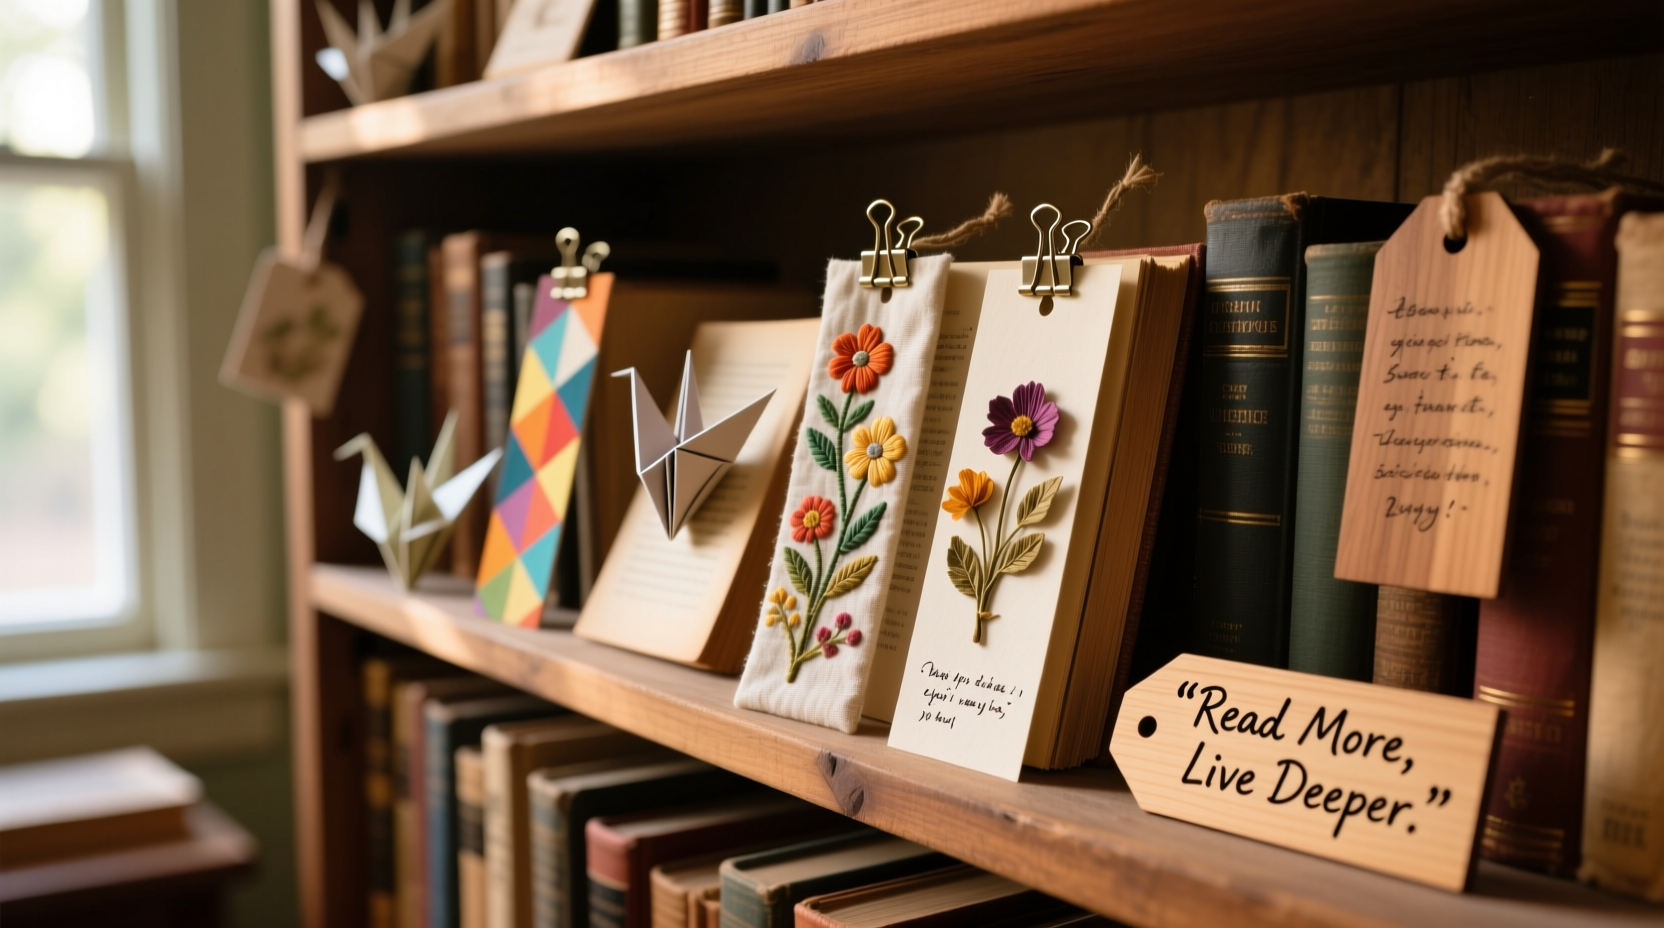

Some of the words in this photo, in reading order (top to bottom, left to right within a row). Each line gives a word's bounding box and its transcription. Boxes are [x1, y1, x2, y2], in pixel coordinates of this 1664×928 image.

[1177, 680, 1292, 741] “Read
[1297, 706, 1415, 776] More,
[1181, 741, 1256, 796] Live
[1266, 758, 1453, 838] Deeper.”
